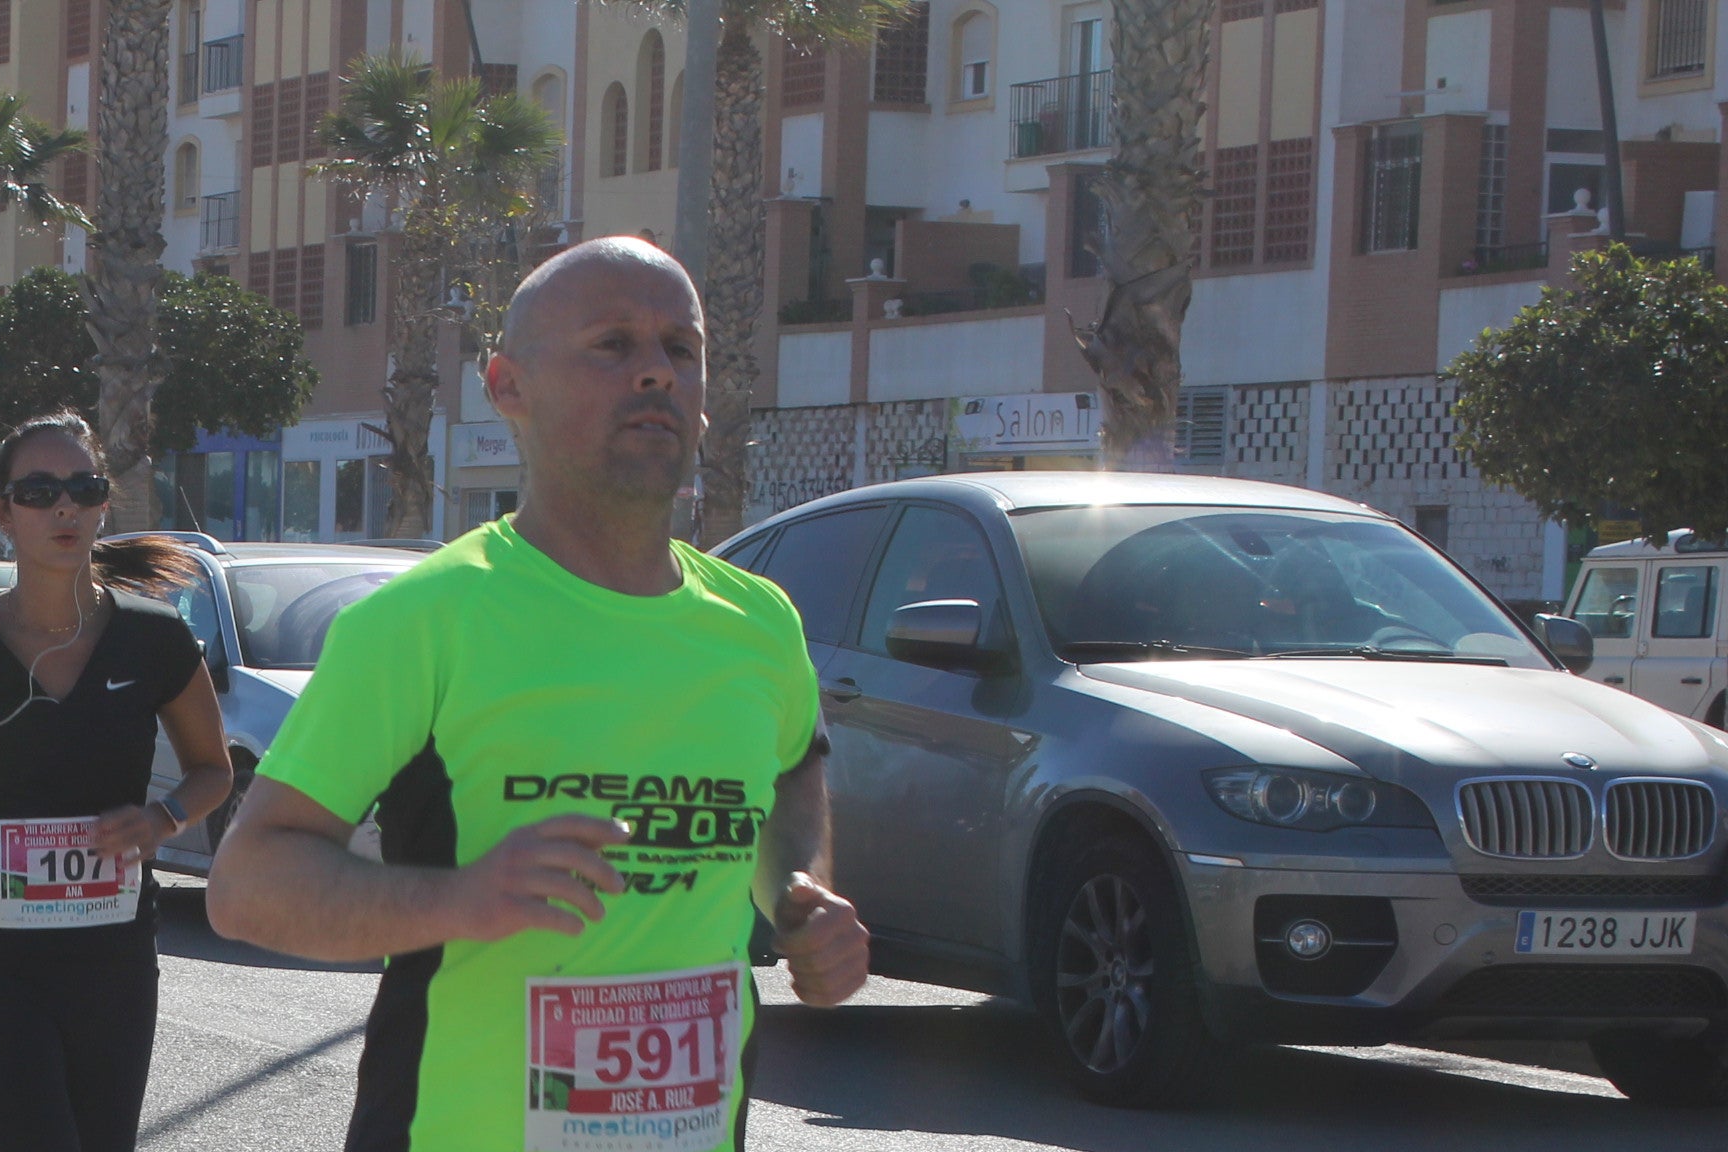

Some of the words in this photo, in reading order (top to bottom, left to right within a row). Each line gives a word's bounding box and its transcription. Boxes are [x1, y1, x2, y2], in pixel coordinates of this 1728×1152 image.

[504, 773, 746, 804] DREAMS
[24, 825, 38, 835] VIII
[40, 824, 78, 835] CARRERA
[24, 836, 55, 847] CIUDAD
[58, 836, 68, 845] DE
[40, 849, 103, 882] 107
[65, 886, 83, 897] ANA
[1543, 916, 1617, 948] 1238
[1630, 917, 1686, 948] JJK
[572, 986, 594, 1005] VIII
[600, 983, 661, 1003] CARRERA
[665, 977, 713, 999] POPULAR
[572, 1006, 627, 1026] CIUDAD
[630, 1005, 646, 1023] DE
[650, 998, 710, 1021] ROQUETAS
[595, 1022, 701, 1084] 591
[610, 1088, 643, 1112] JOSÉ
[665, 1088, 695, 1109] RUIZ
